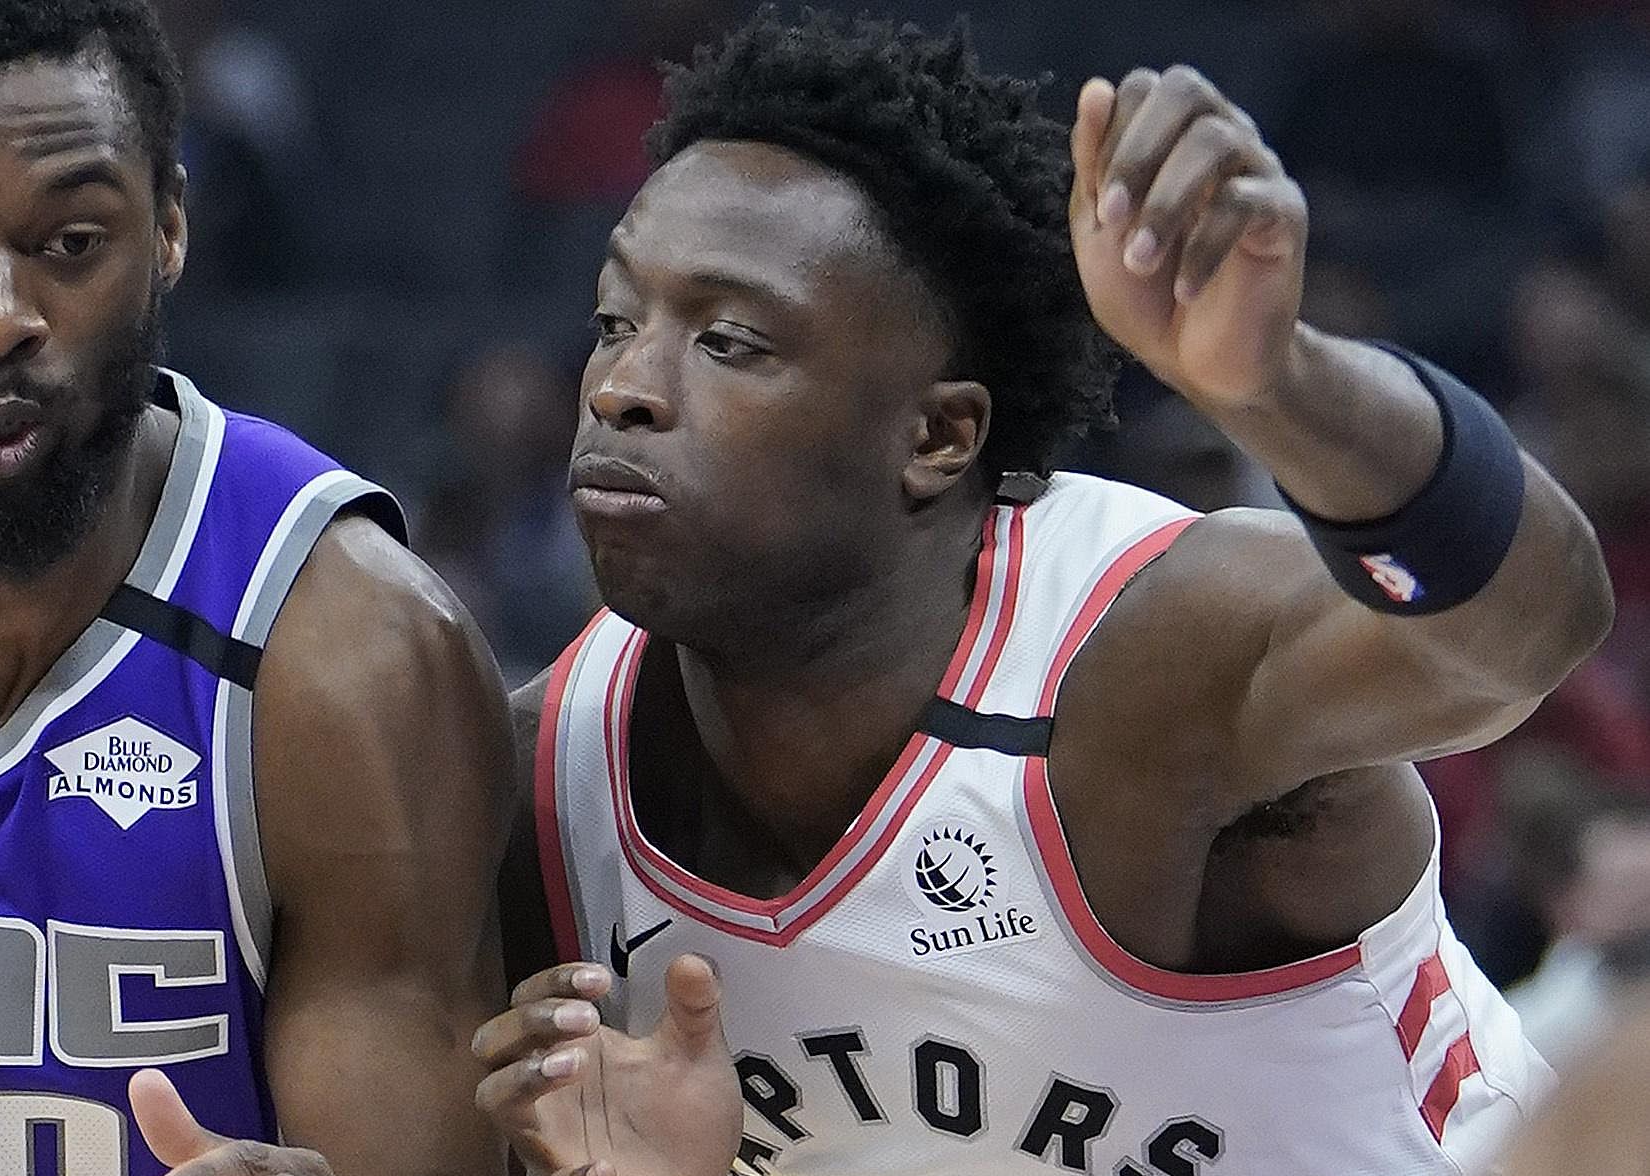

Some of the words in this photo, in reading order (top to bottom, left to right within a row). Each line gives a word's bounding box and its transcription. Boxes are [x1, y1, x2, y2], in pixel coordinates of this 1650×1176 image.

[108, 736, 152, 758] BLUE
[83, 752, 173, 774] DIAMOND
[54, 775, 192, 805] ALMONDS
[910, 927, 975, 956] Sun
[975, 908, 1038, 943] Life
